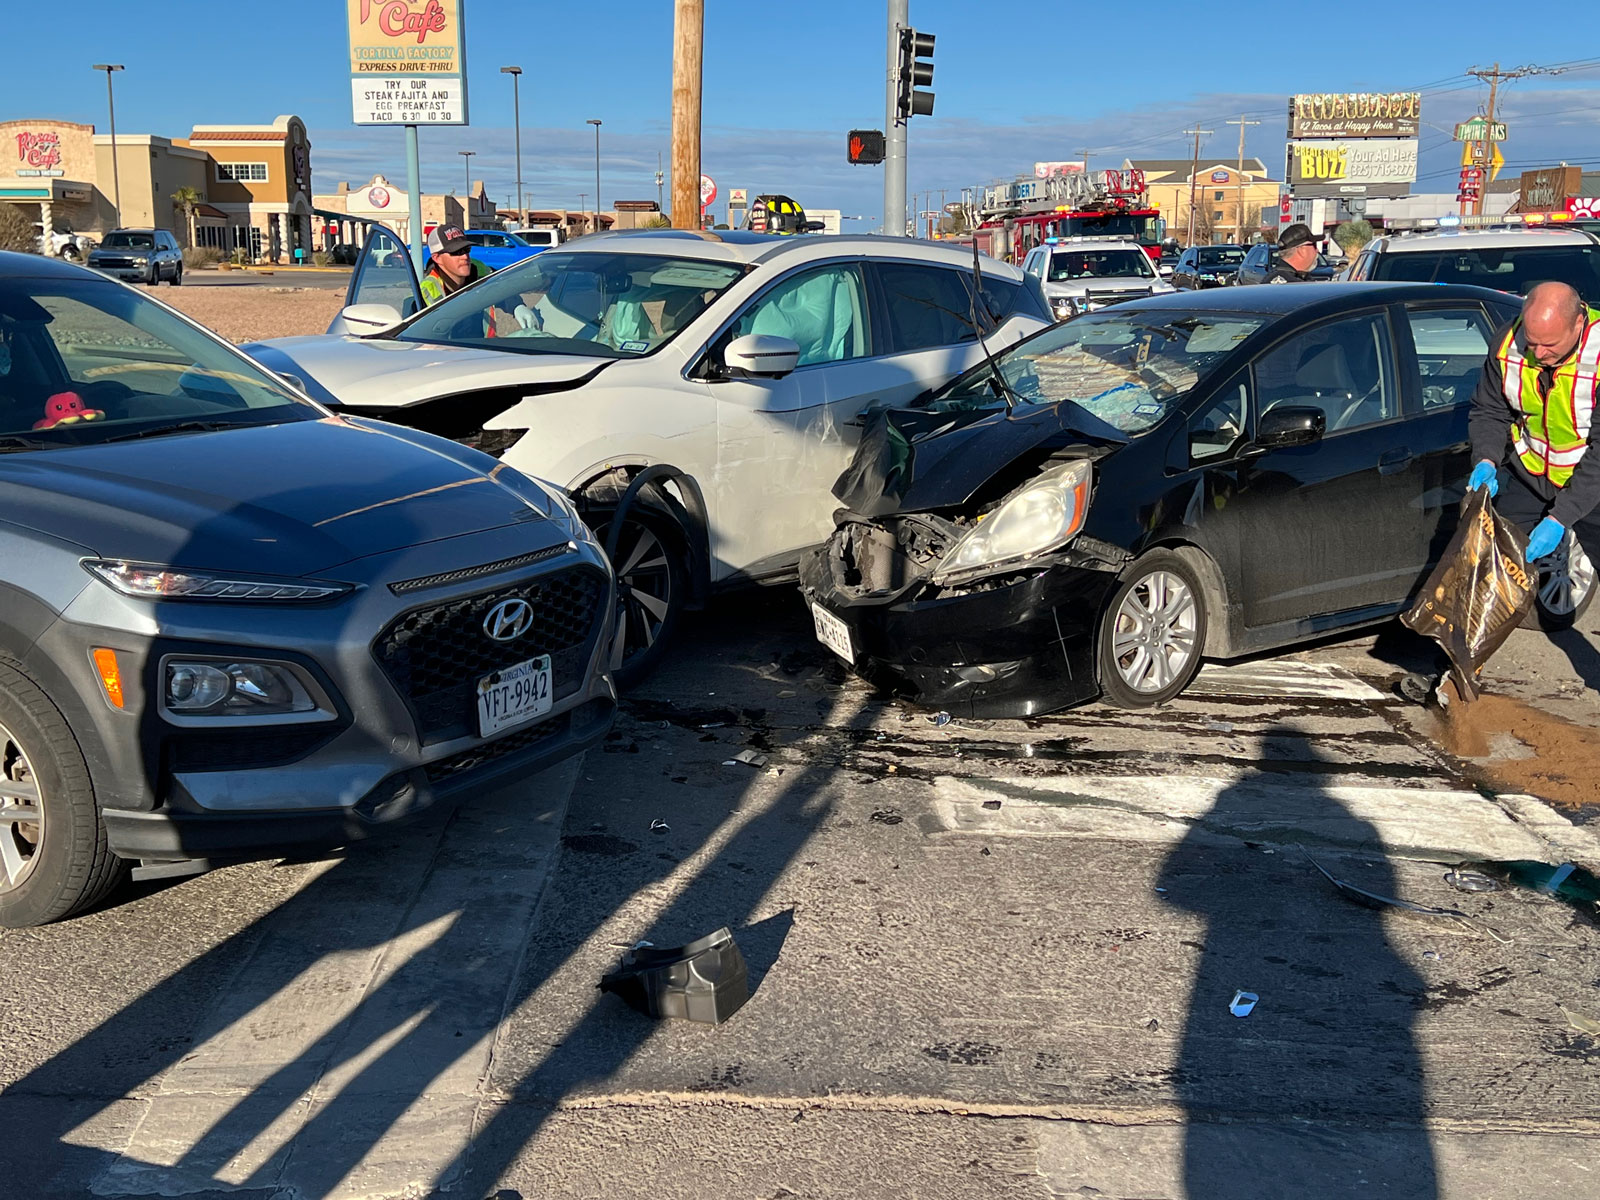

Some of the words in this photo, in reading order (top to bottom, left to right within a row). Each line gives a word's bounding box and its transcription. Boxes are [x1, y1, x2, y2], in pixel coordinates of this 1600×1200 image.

[379, 0, 447, 44] Café
[354, 46, 405, 60] TORTILLA
[407, 46, 454, 60] FACTORY
[359, 62, 397, 72] EXPRESS
[399, 62, 453, 72] DRIVE-THRU
[385, 80, 401, 90] TRY
[411, 80, 427, 90] OUR
[365, 91, 393, 101] STEAK
[395, 91, 428, 100] FAJITA
[431, 91, 449, 100] AND
[376, 101, 393, 111] EGG
[371, 112, 393, 121] TACO
[402, 112, 408, 121] 6
[428, 112, 437, 121] 10
[441, 112, 452, 121] 30
[1300, 121, 1310, 131] $2
[1312, 120, 1333, 131] Tacos
[1334, 120, 1344, 131] at
[1344, 120, 1372, 134] Happy
[1373, 120, 1394, 131] Hour
[1460, 124, 1481, 141] TWIN
[1482, 124, 1505, 141] PAKS
[1294, 146, 1322, 158] CREATE
[1351, 149, 1373, 163] Your
[1375, 149, 1391, 163] Ad
[1392, 149, 1417, 162] Here
[1301, 156, 1347, 179] BUZZ
[1351, 163, 1374, 179] (325)
[1374, 163, 1416, 177] 716-3277
[1005, 184, 1030, 200] LADDER
[1032, 183, 1036, 197] 7
[501, 664, 533, 682] IRGINIA
[484, 671, 547, 719] VFT-9942
